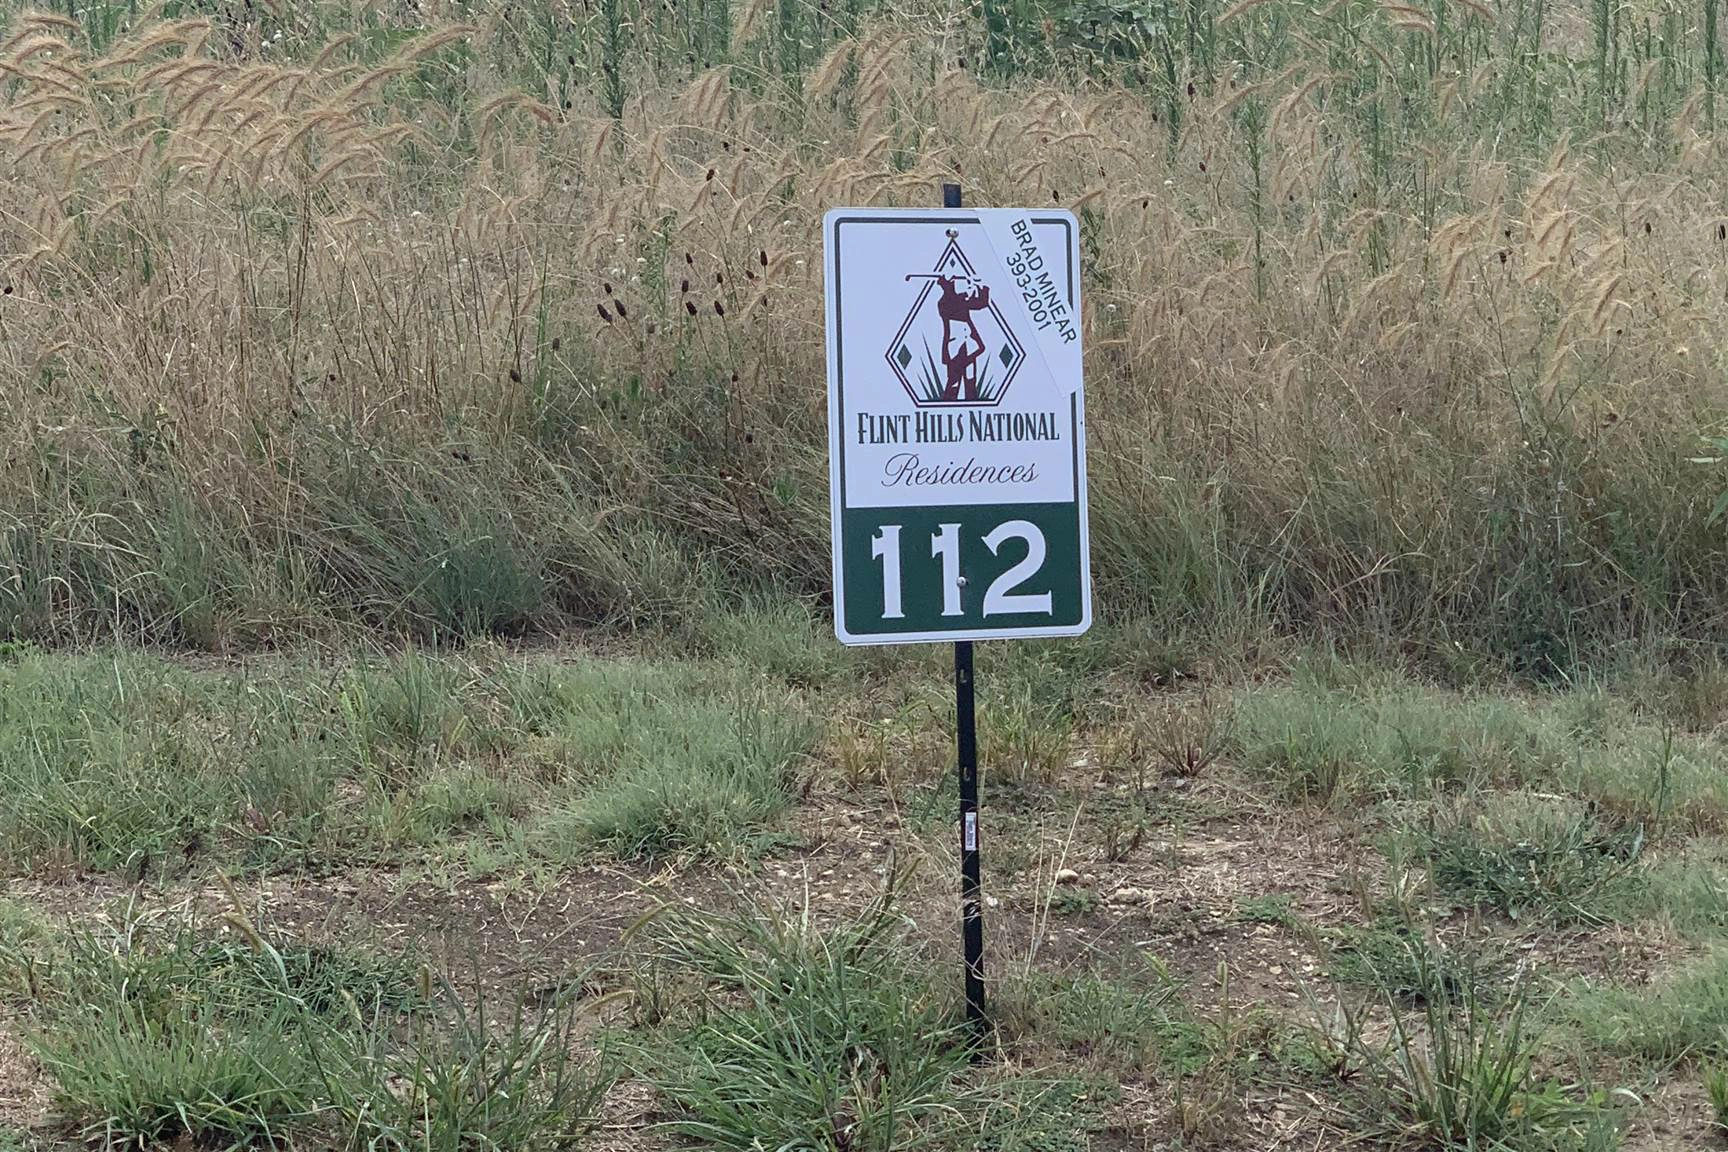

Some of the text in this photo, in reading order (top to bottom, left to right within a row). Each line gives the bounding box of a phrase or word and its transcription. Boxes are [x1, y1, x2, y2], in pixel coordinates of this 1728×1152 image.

[1006, 252, 1052, 332] 393-2001
[1010, 219, 1077, 345] BRAD MINEAR
[857, 410, 1060, 445] FLINT HILLS NATIONAL
[881, 452, 1039, 487] Residences
[872, 519, 1053, 619] 112
